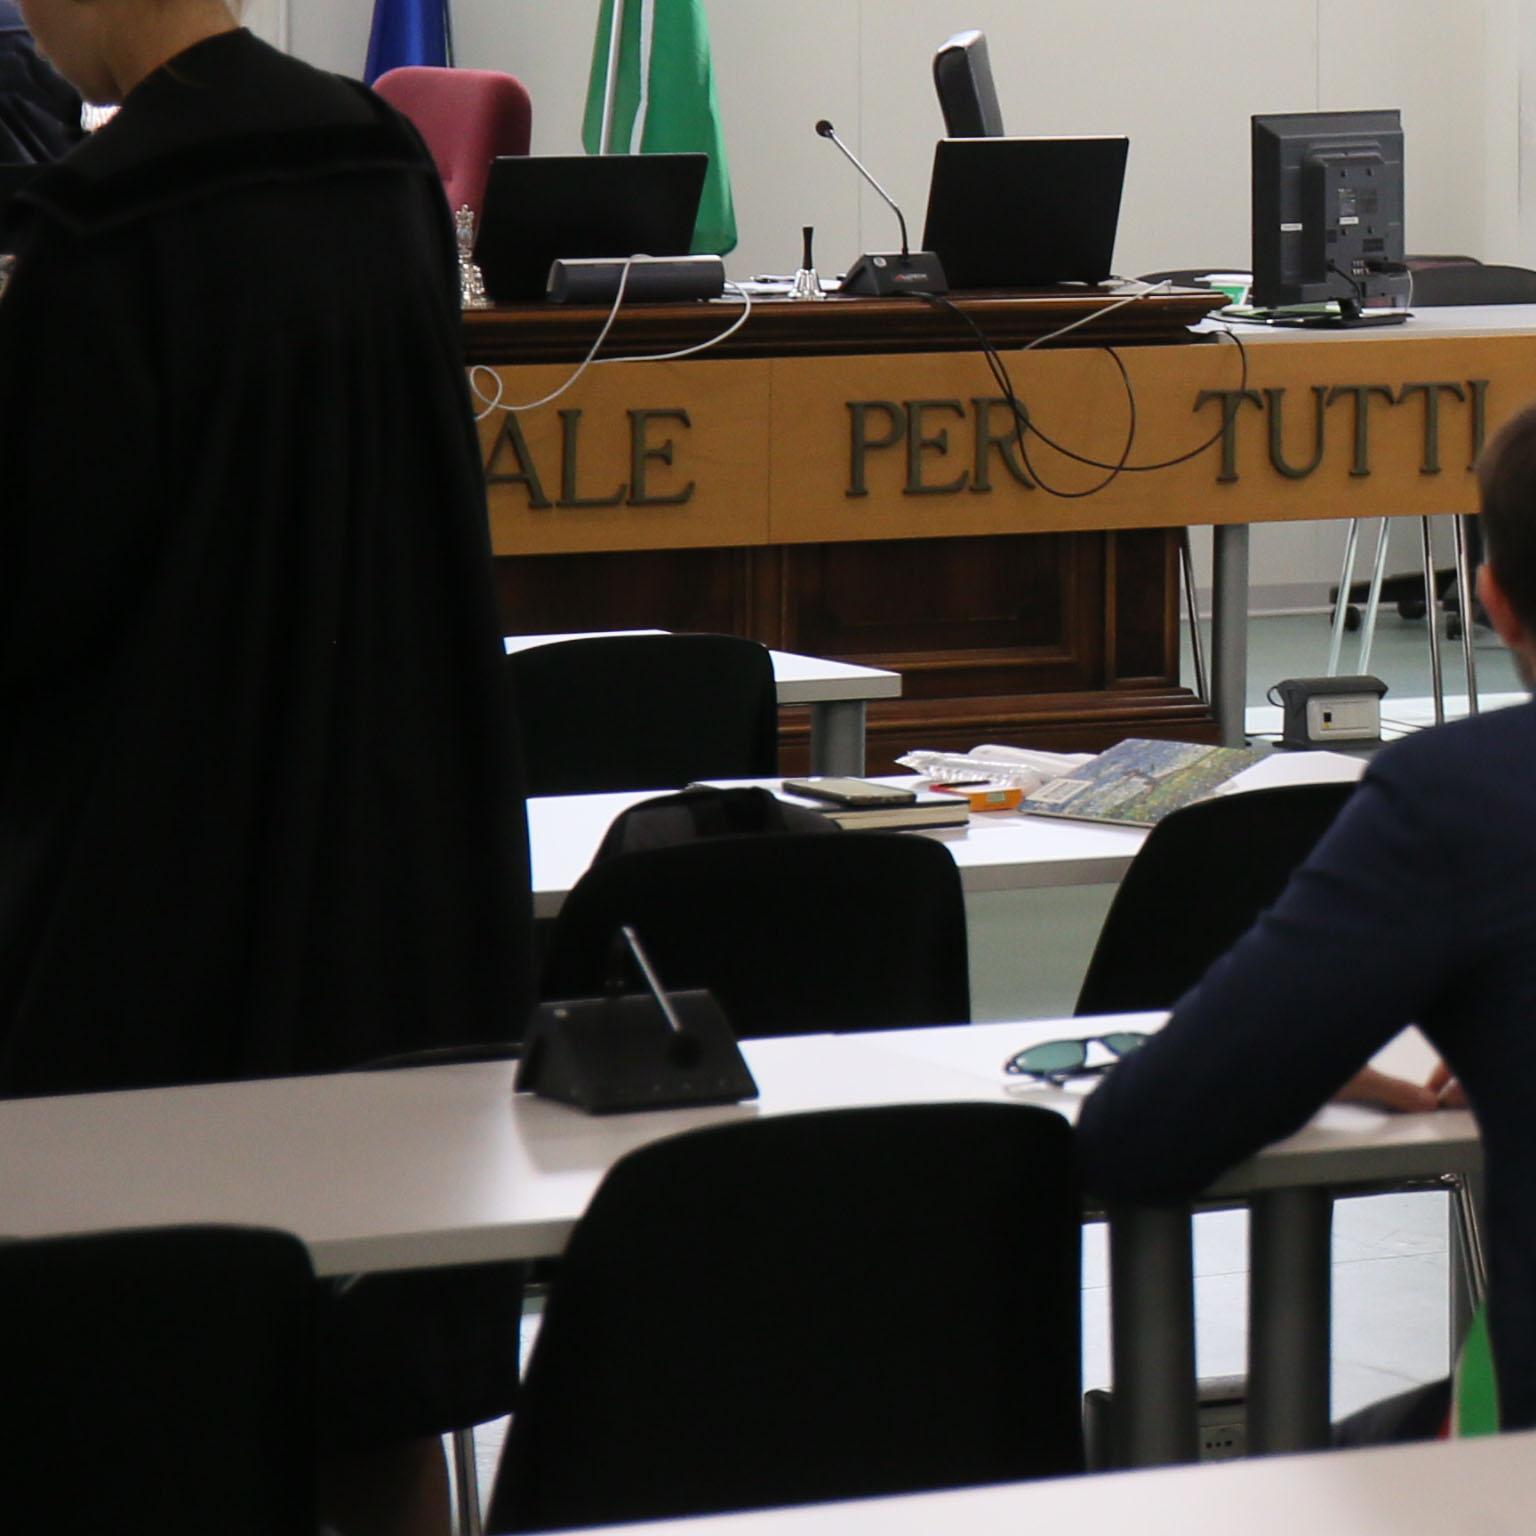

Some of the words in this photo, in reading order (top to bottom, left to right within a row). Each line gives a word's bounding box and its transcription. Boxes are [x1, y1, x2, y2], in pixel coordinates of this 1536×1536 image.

[484, 408, 696, 508] ALE
[845, 396, 1036, 497] PER
[1193, 379, 1490, 484] TUTTI
